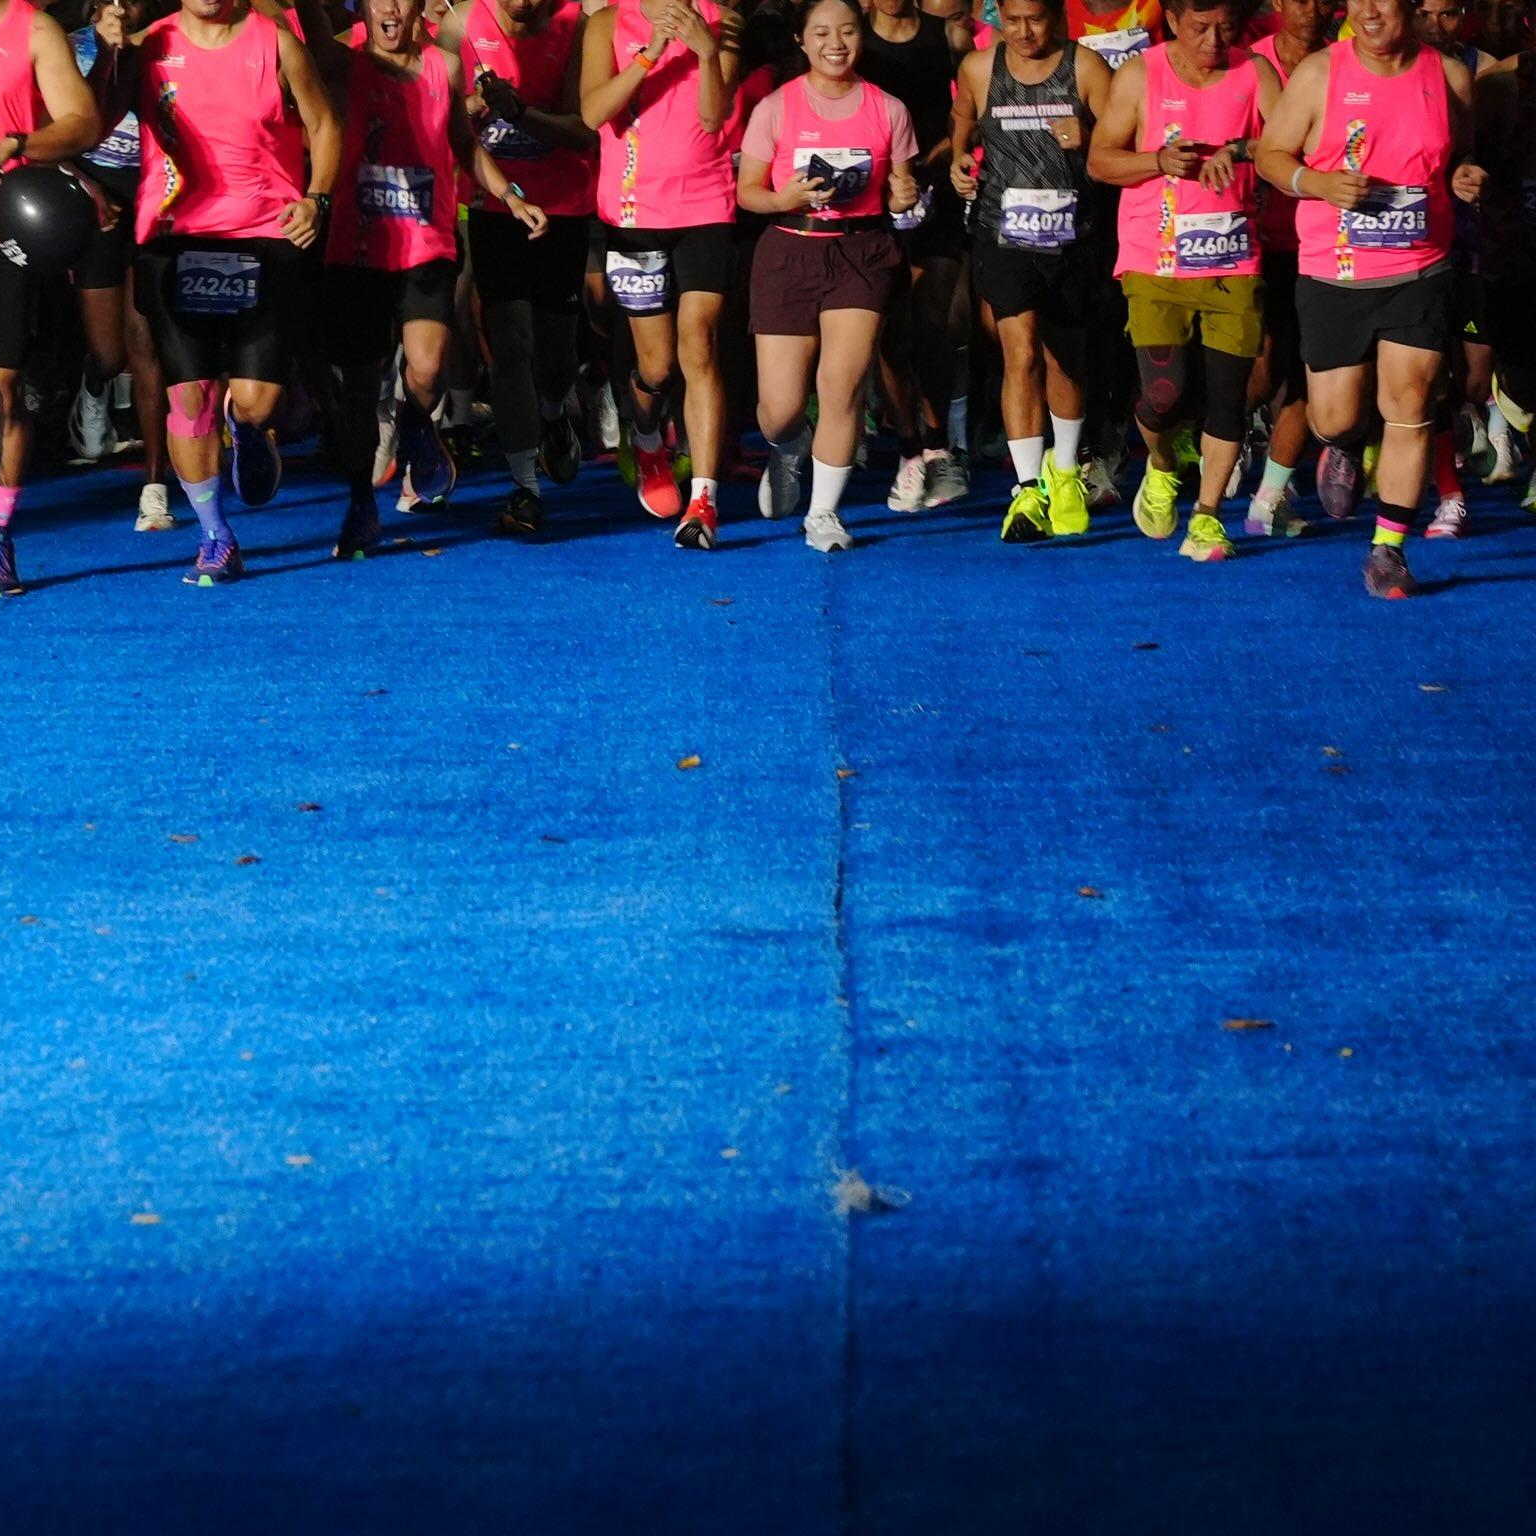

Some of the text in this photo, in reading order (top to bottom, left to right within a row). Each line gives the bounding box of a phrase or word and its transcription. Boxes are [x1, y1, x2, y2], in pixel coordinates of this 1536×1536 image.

[1005, 212, 1064, 231] 24607
[1352, 210, 1416, 230] 25373
[1179, 233, 1240, 257] 24606
[181, 276, 245, 296] 24243
[611, 273, 666, 294] 24259
